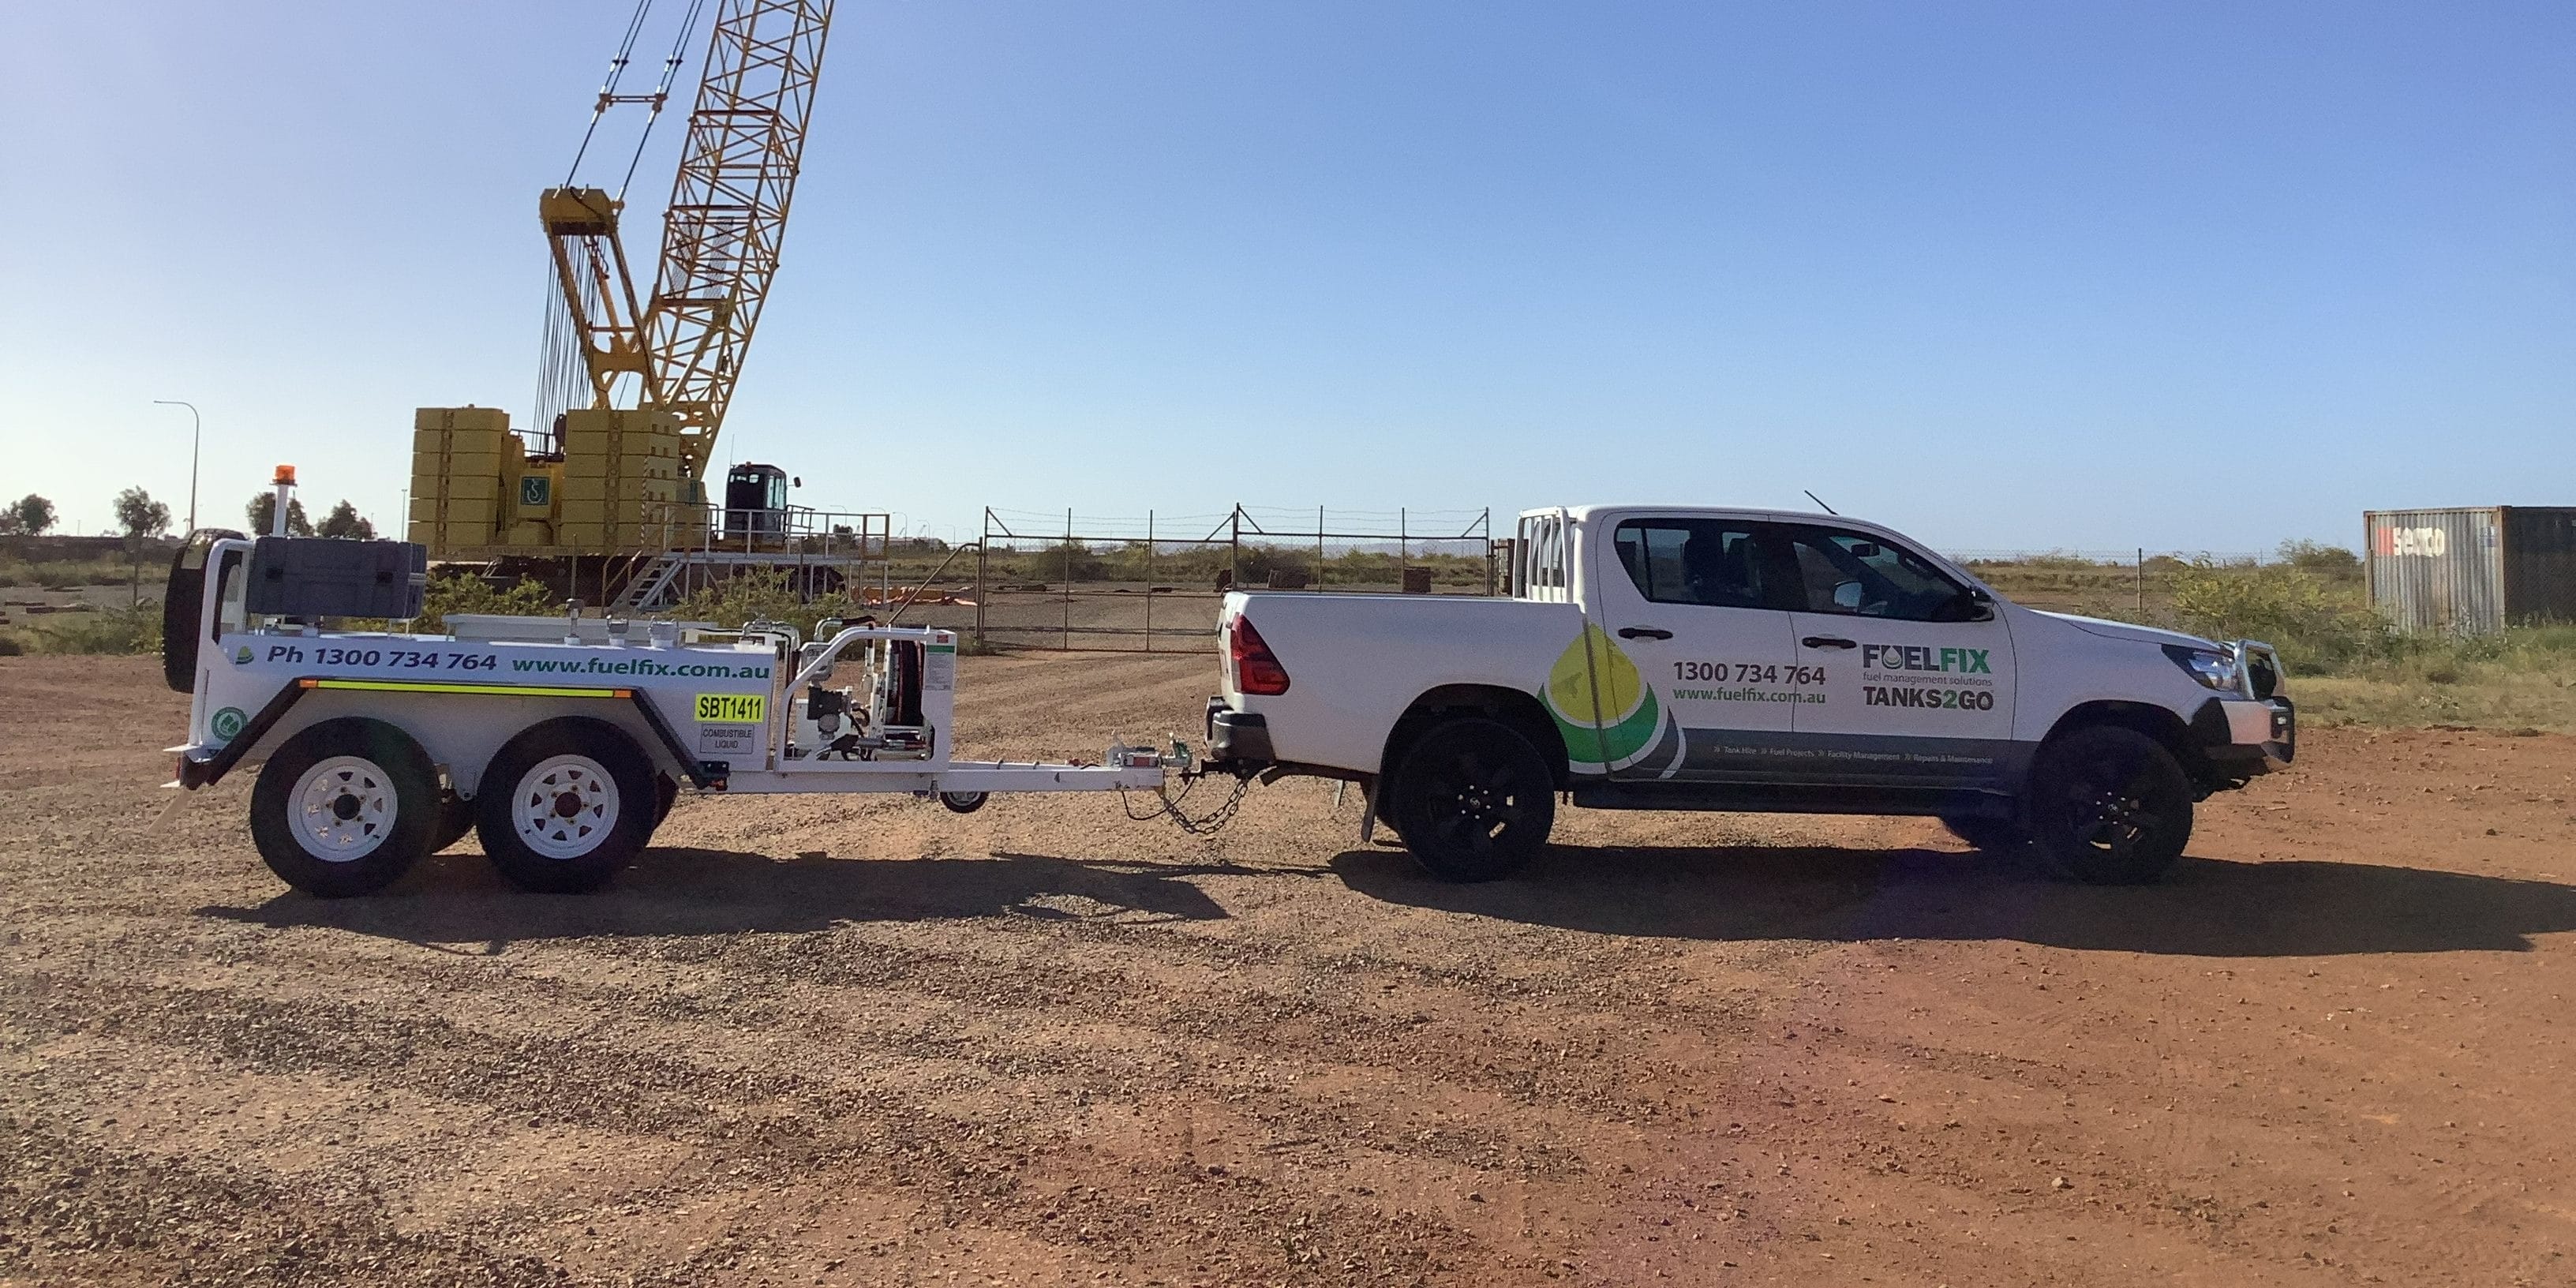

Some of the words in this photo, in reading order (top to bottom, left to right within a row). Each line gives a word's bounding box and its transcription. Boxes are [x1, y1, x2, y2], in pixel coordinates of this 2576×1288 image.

[267, 646, 304, 664] Ph
[316, 648, 380, 666] 1300
[387, 650, 439, 668] 734
[446, 653, 497, 671] 764
[511, 657, 769, 679] www.fuelfix.com.au
[1863, 644, 1991, 674] FUELFIX
[1673, 661, 1728, 682] 1300
[1735, 664, 1778, 683] 734
[1784, 665, 1826, 685] 764
[1863, 672, 1881, 681] fuel
[1883, 675, 1947, 685] management
[1949, 676, 1993, 686] solutions
[1672, 687, 1826, 704] www.fuelfix.com.au
[1863, 686, 1994, 710] TANKS2GO
[699, 697, 761, 719] SBT1411
[702, 728, 752, 738] COMBUSTIBLE
[715, 740, 739, 749] LIQUID
